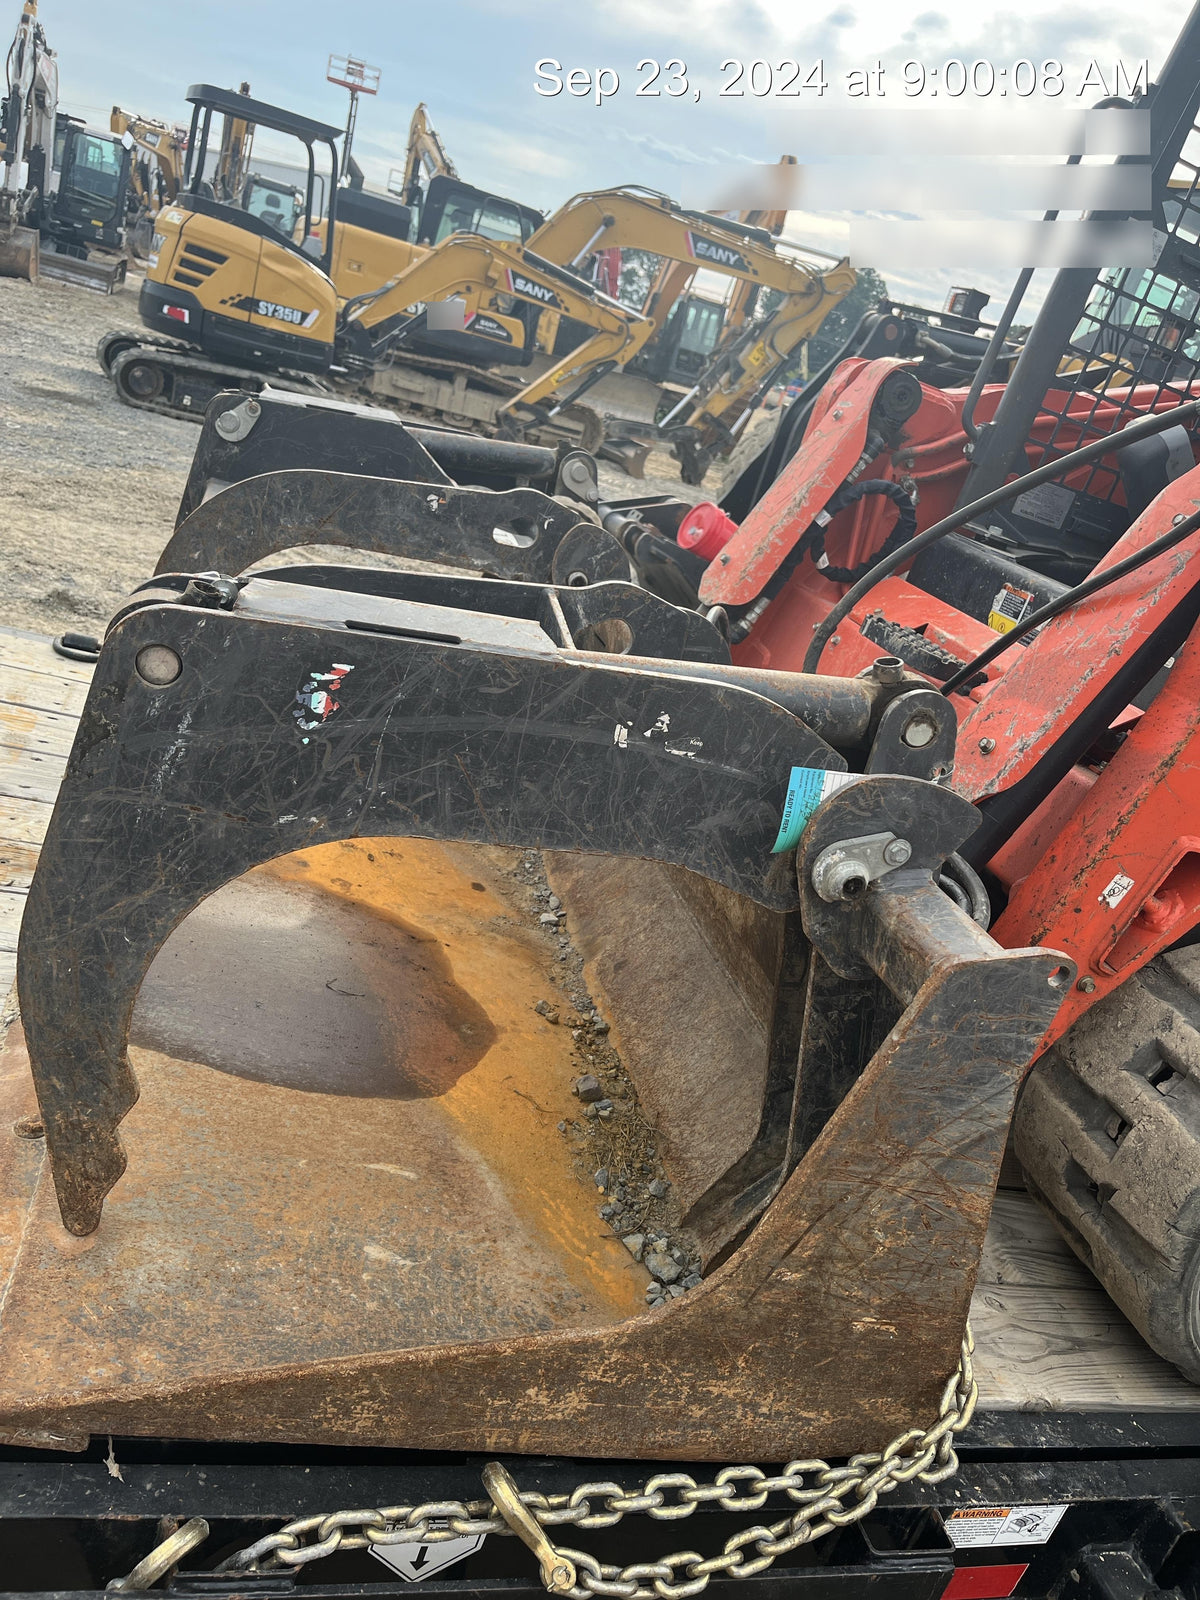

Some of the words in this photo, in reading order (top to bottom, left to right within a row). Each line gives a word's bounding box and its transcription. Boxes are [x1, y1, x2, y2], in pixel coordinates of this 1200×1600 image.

[696, 242, 739, 265] SANY
[514, 277, 555, 303] SANY
[257, 300, 303, 325] SY35U
[787, 789, 796, 810] READY
[785, 810, 792, 818] TO
[781, 819, 790, 834] RENT
[962, 1510, 1004, 1518] WARNING
